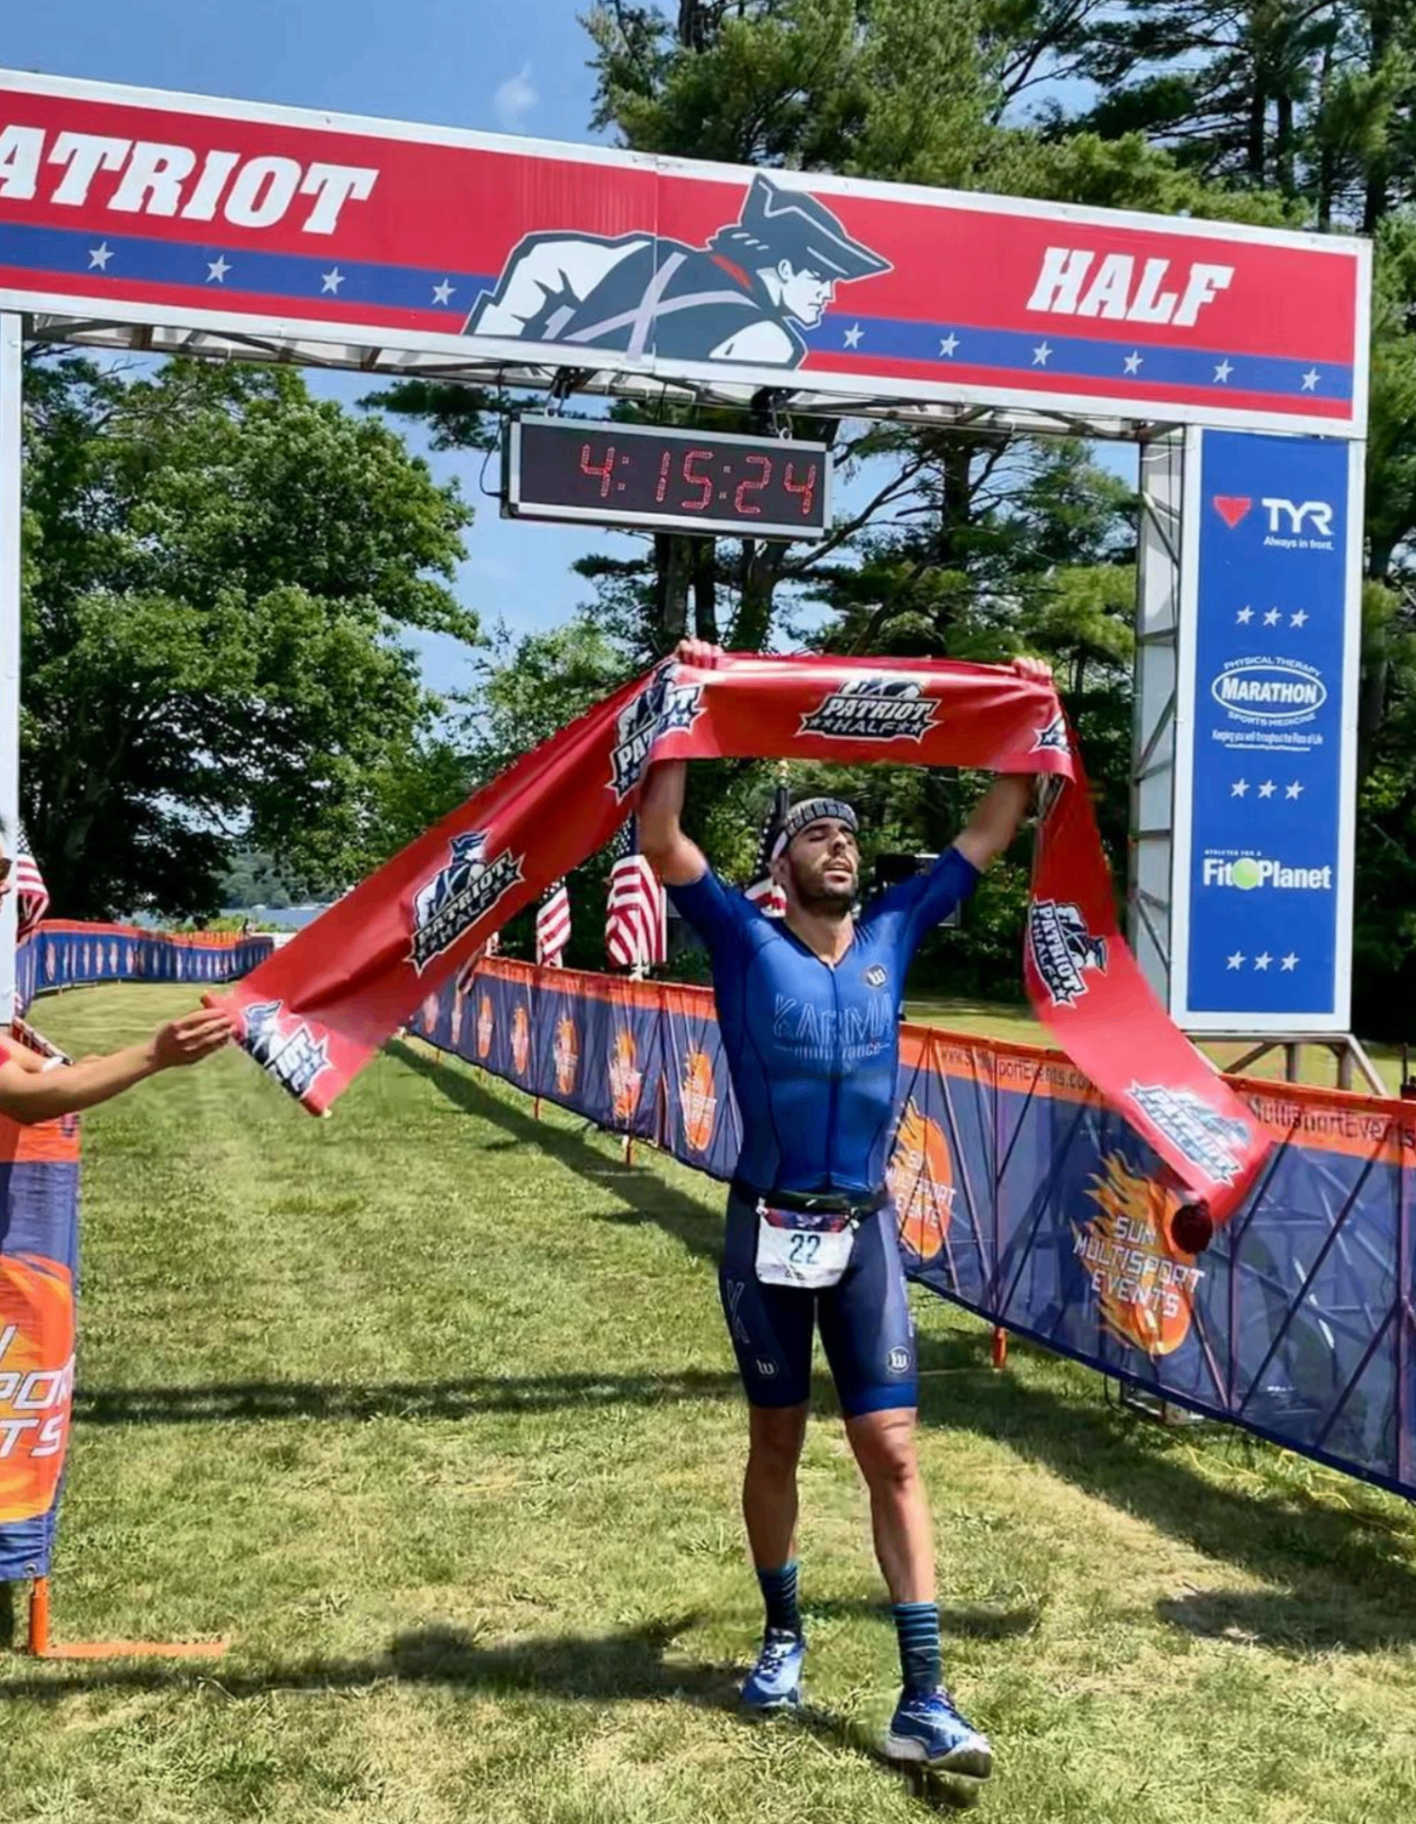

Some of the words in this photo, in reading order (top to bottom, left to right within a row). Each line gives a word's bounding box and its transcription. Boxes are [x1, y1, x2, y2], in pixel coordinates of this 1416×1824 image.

[1026, 246, 1235, 327] HALF
[581, 444, 817, 515] 4:15:24
[1262, 497, 1335, 536] TYR
[1264, 536, 1297, 549] Always
[1299, 538, 1308, 548] in
[1223, 655, 1274, 670] PHYSICAL
[1275, 656, 1322, 677] THERAPY
[822, 698, 933, 721] PATRIOT
[1221, 677, 1318, 704] MARATHON
[832, 719, 897, 734] HALF
[418, 856, 508, 945] PATRIOT
[439, 889, 493, 944] HALF
[1039, 905, 1082, 991] PATRIOT
[789, 1234, 821, 1265] 22
[1115, 1215, 1157, 1245] SUN
[1073, 1233, 1206, 1293] MULTISPORT
[1091, 1268, 1180, 1318] EVENTS
